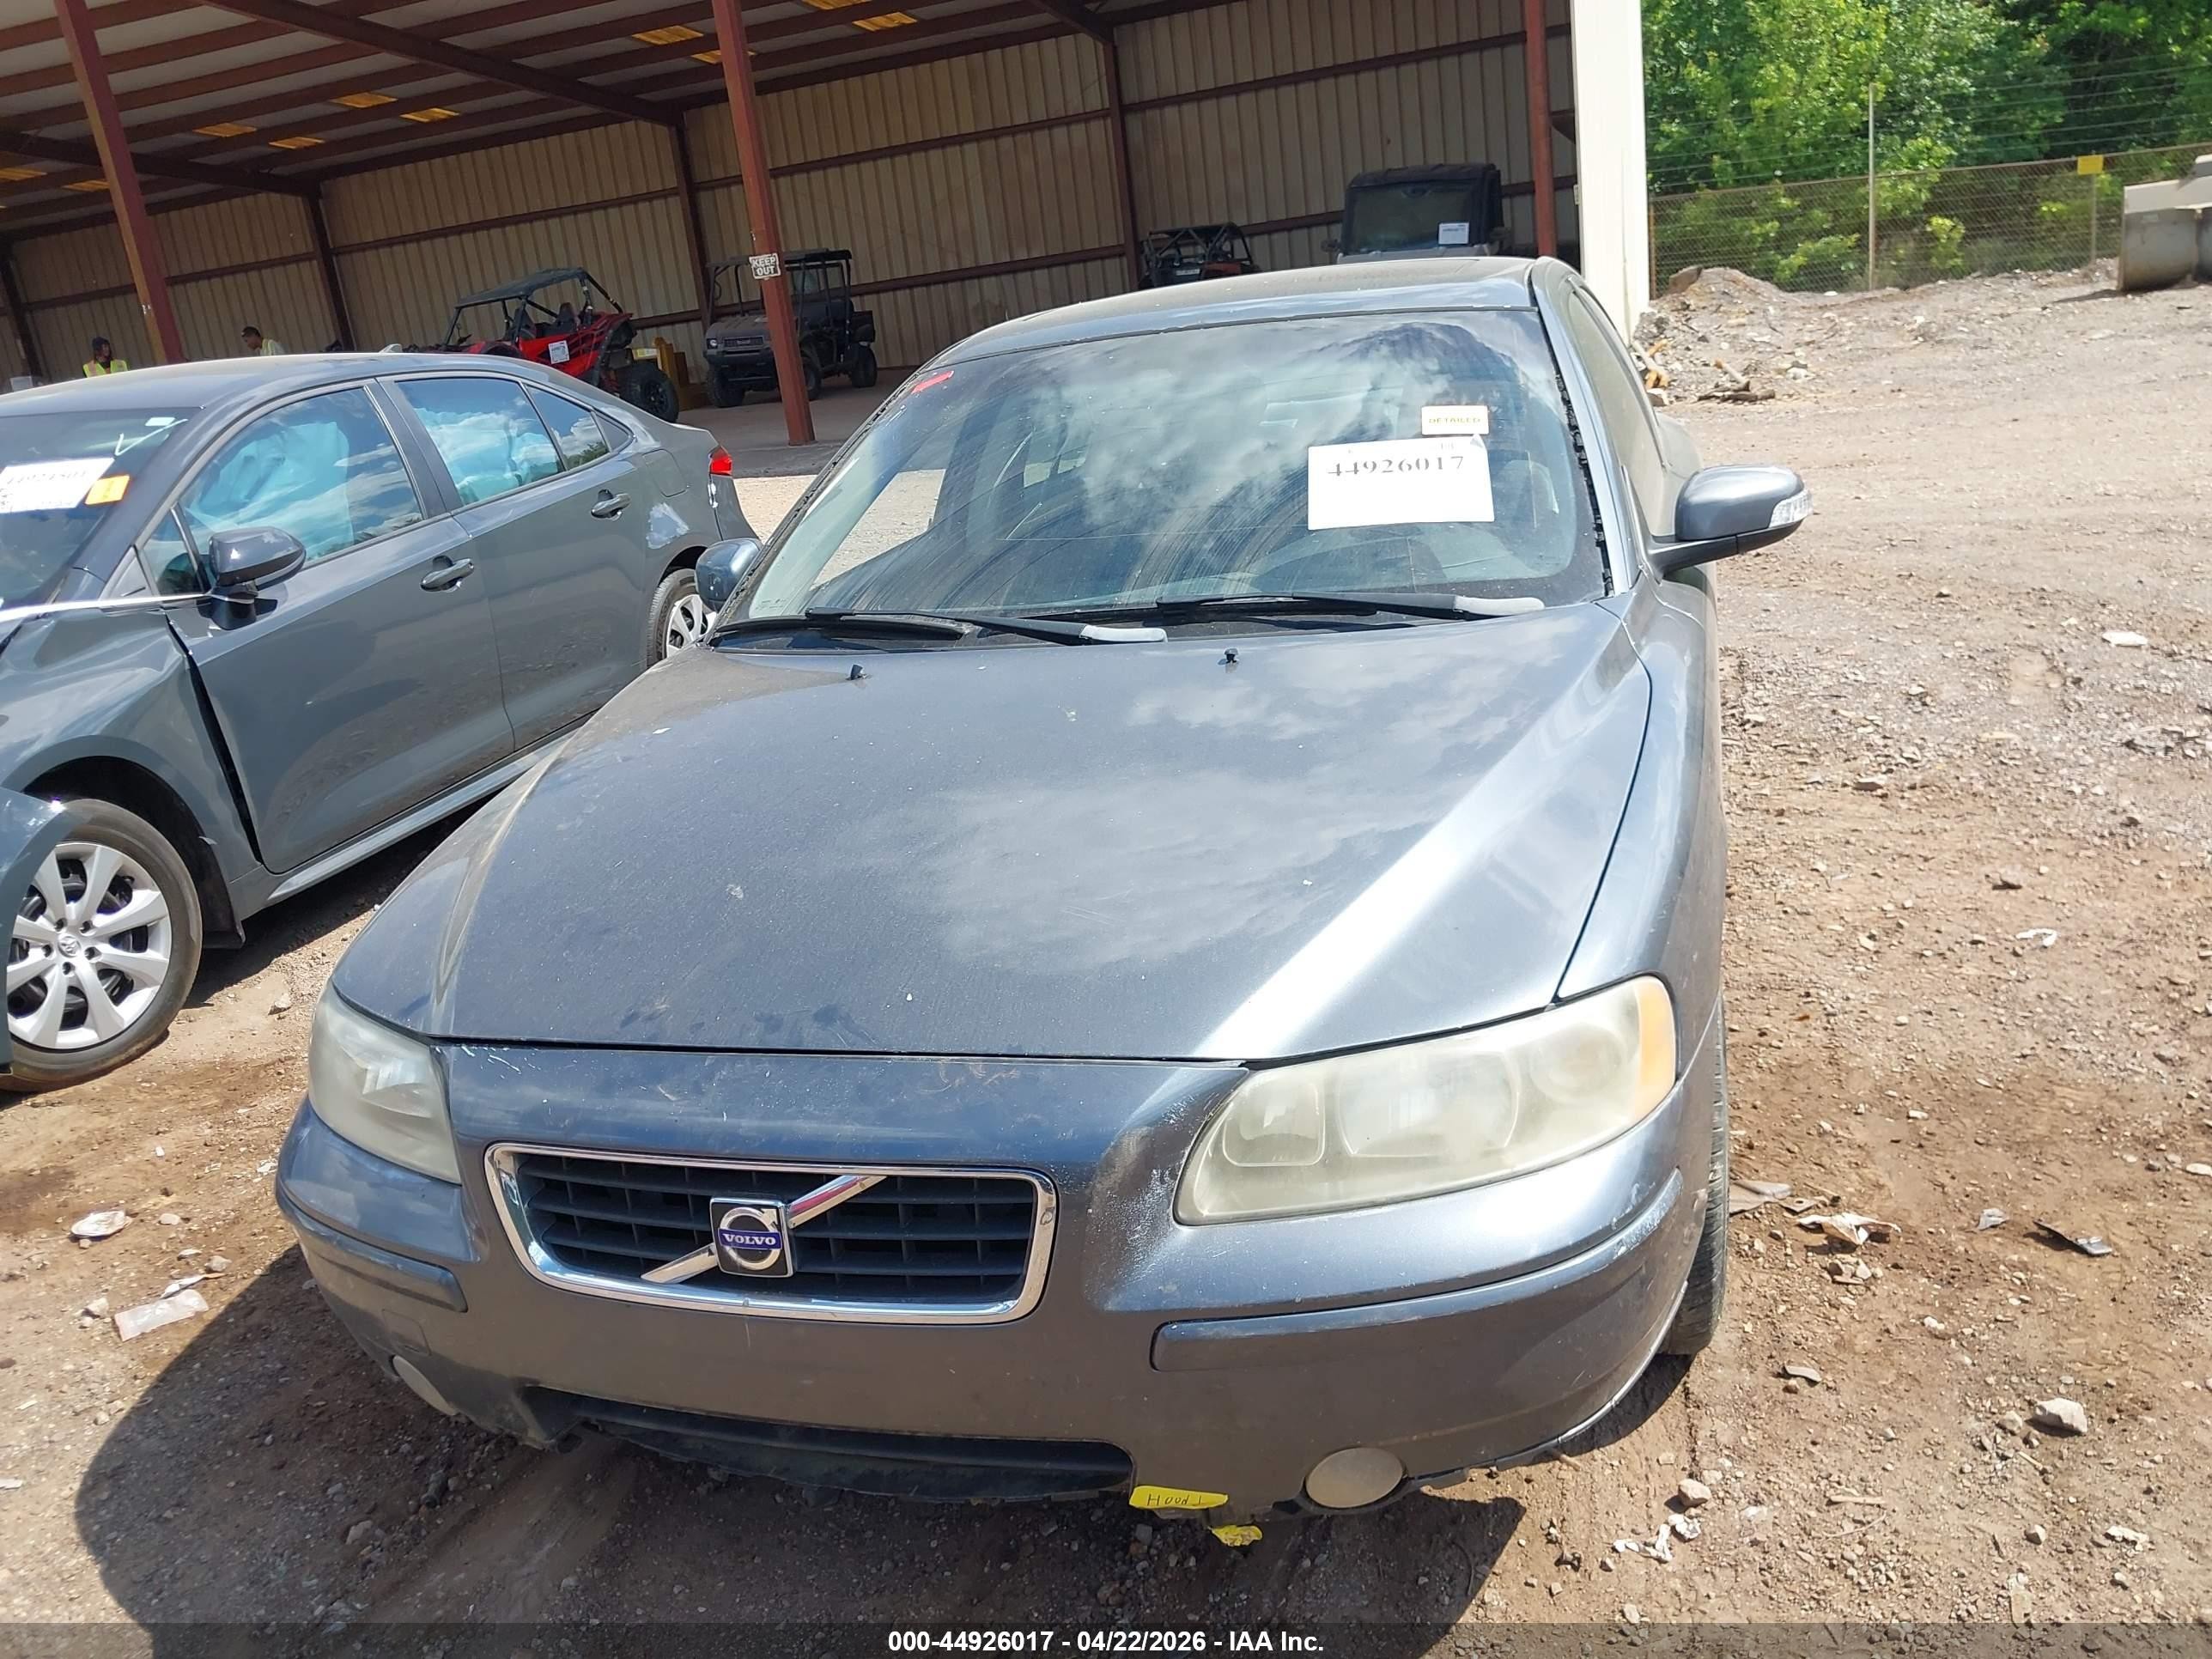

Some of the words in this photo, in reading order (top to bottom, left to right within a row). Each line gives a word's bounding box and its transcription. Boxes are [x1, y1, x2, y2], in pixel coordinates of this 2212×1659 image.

[751, 257, 775, 267] KEEP
[757, 266, 775, 276] OUT
[1328, 456, 1464, 477] 44926017
[722, 1233, 776, 1246] VOLVO
